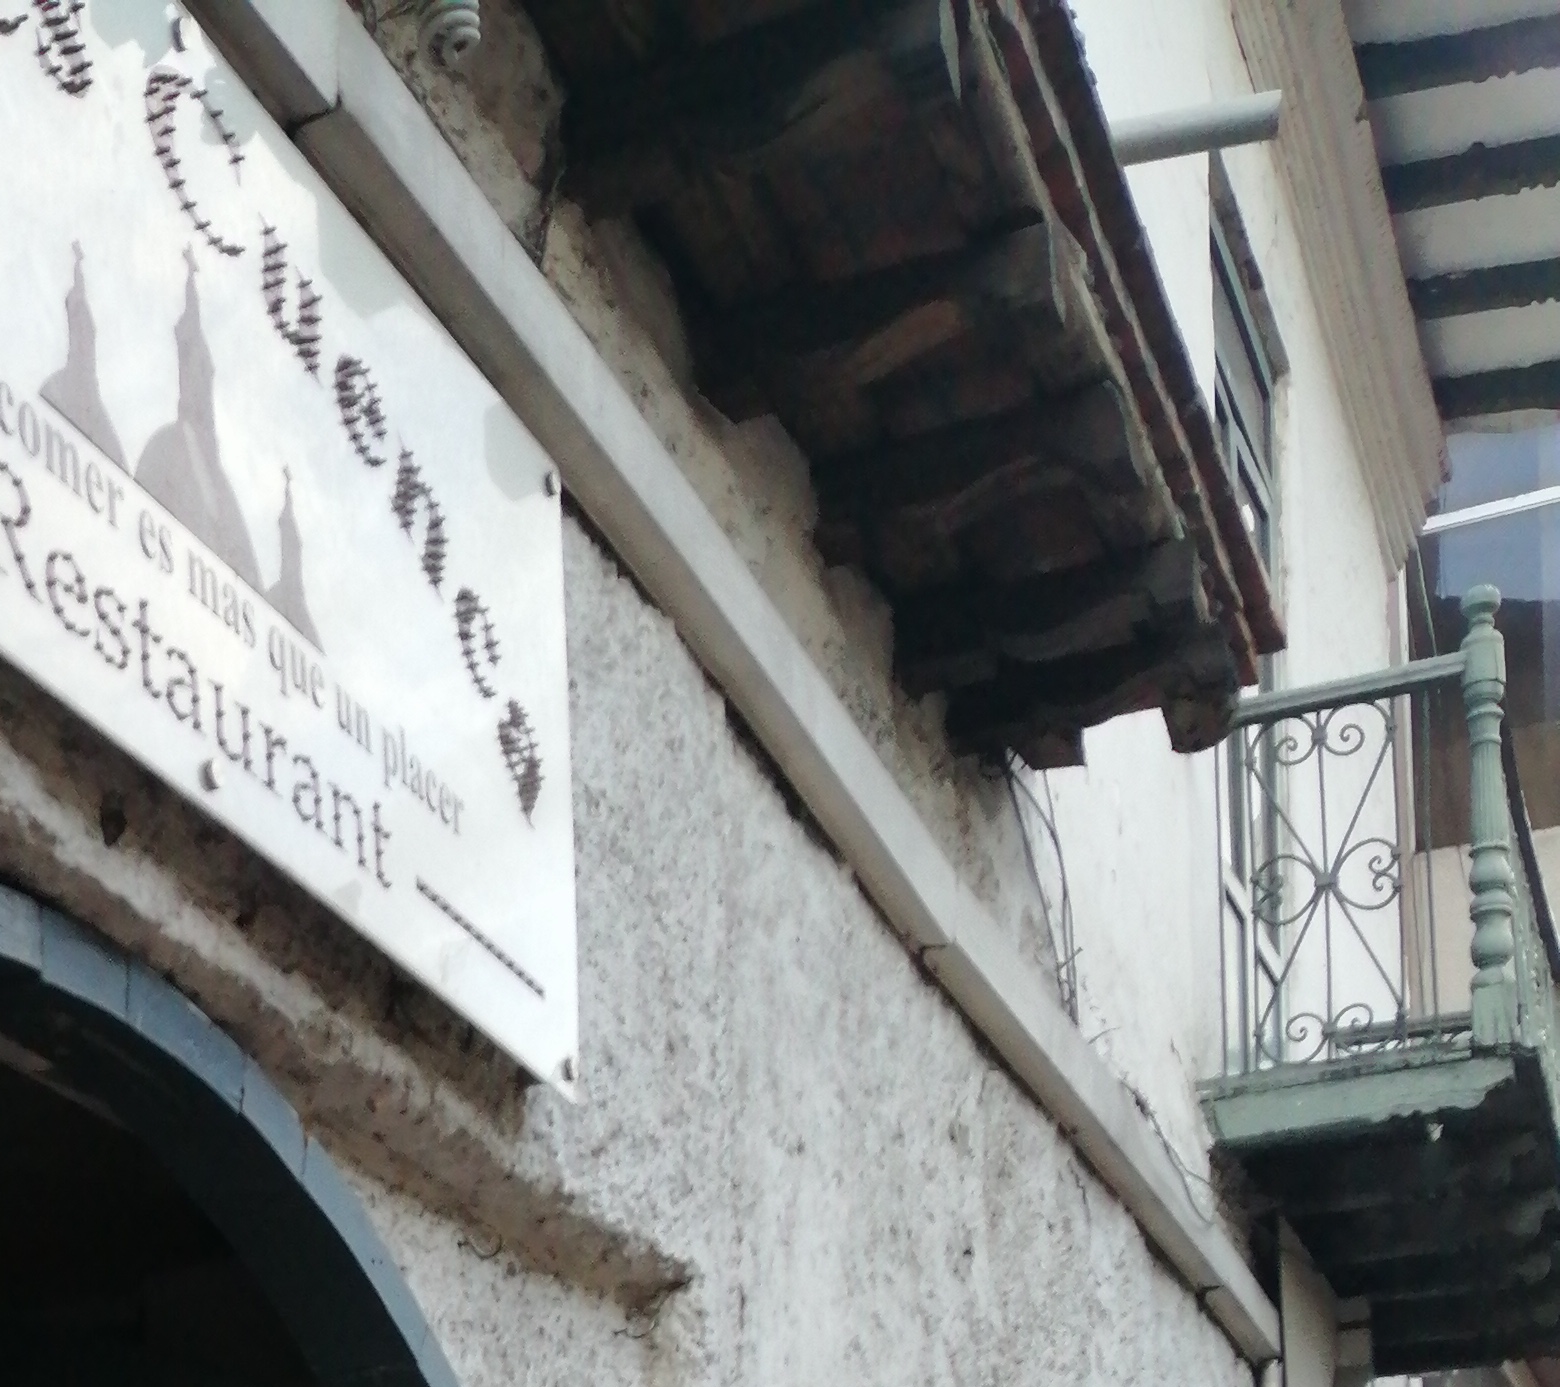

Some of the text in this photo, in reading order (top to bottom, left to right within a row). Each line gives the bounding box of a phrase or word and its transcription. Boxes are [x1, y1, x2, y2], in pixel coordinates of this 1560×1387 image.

[138, 508, 175, 575] es
[186, 546, 258, 649] mas
[268, 624, 326, 711] que
[335, 682, 374, 755] un
[381, 724, 465, 837] placer
